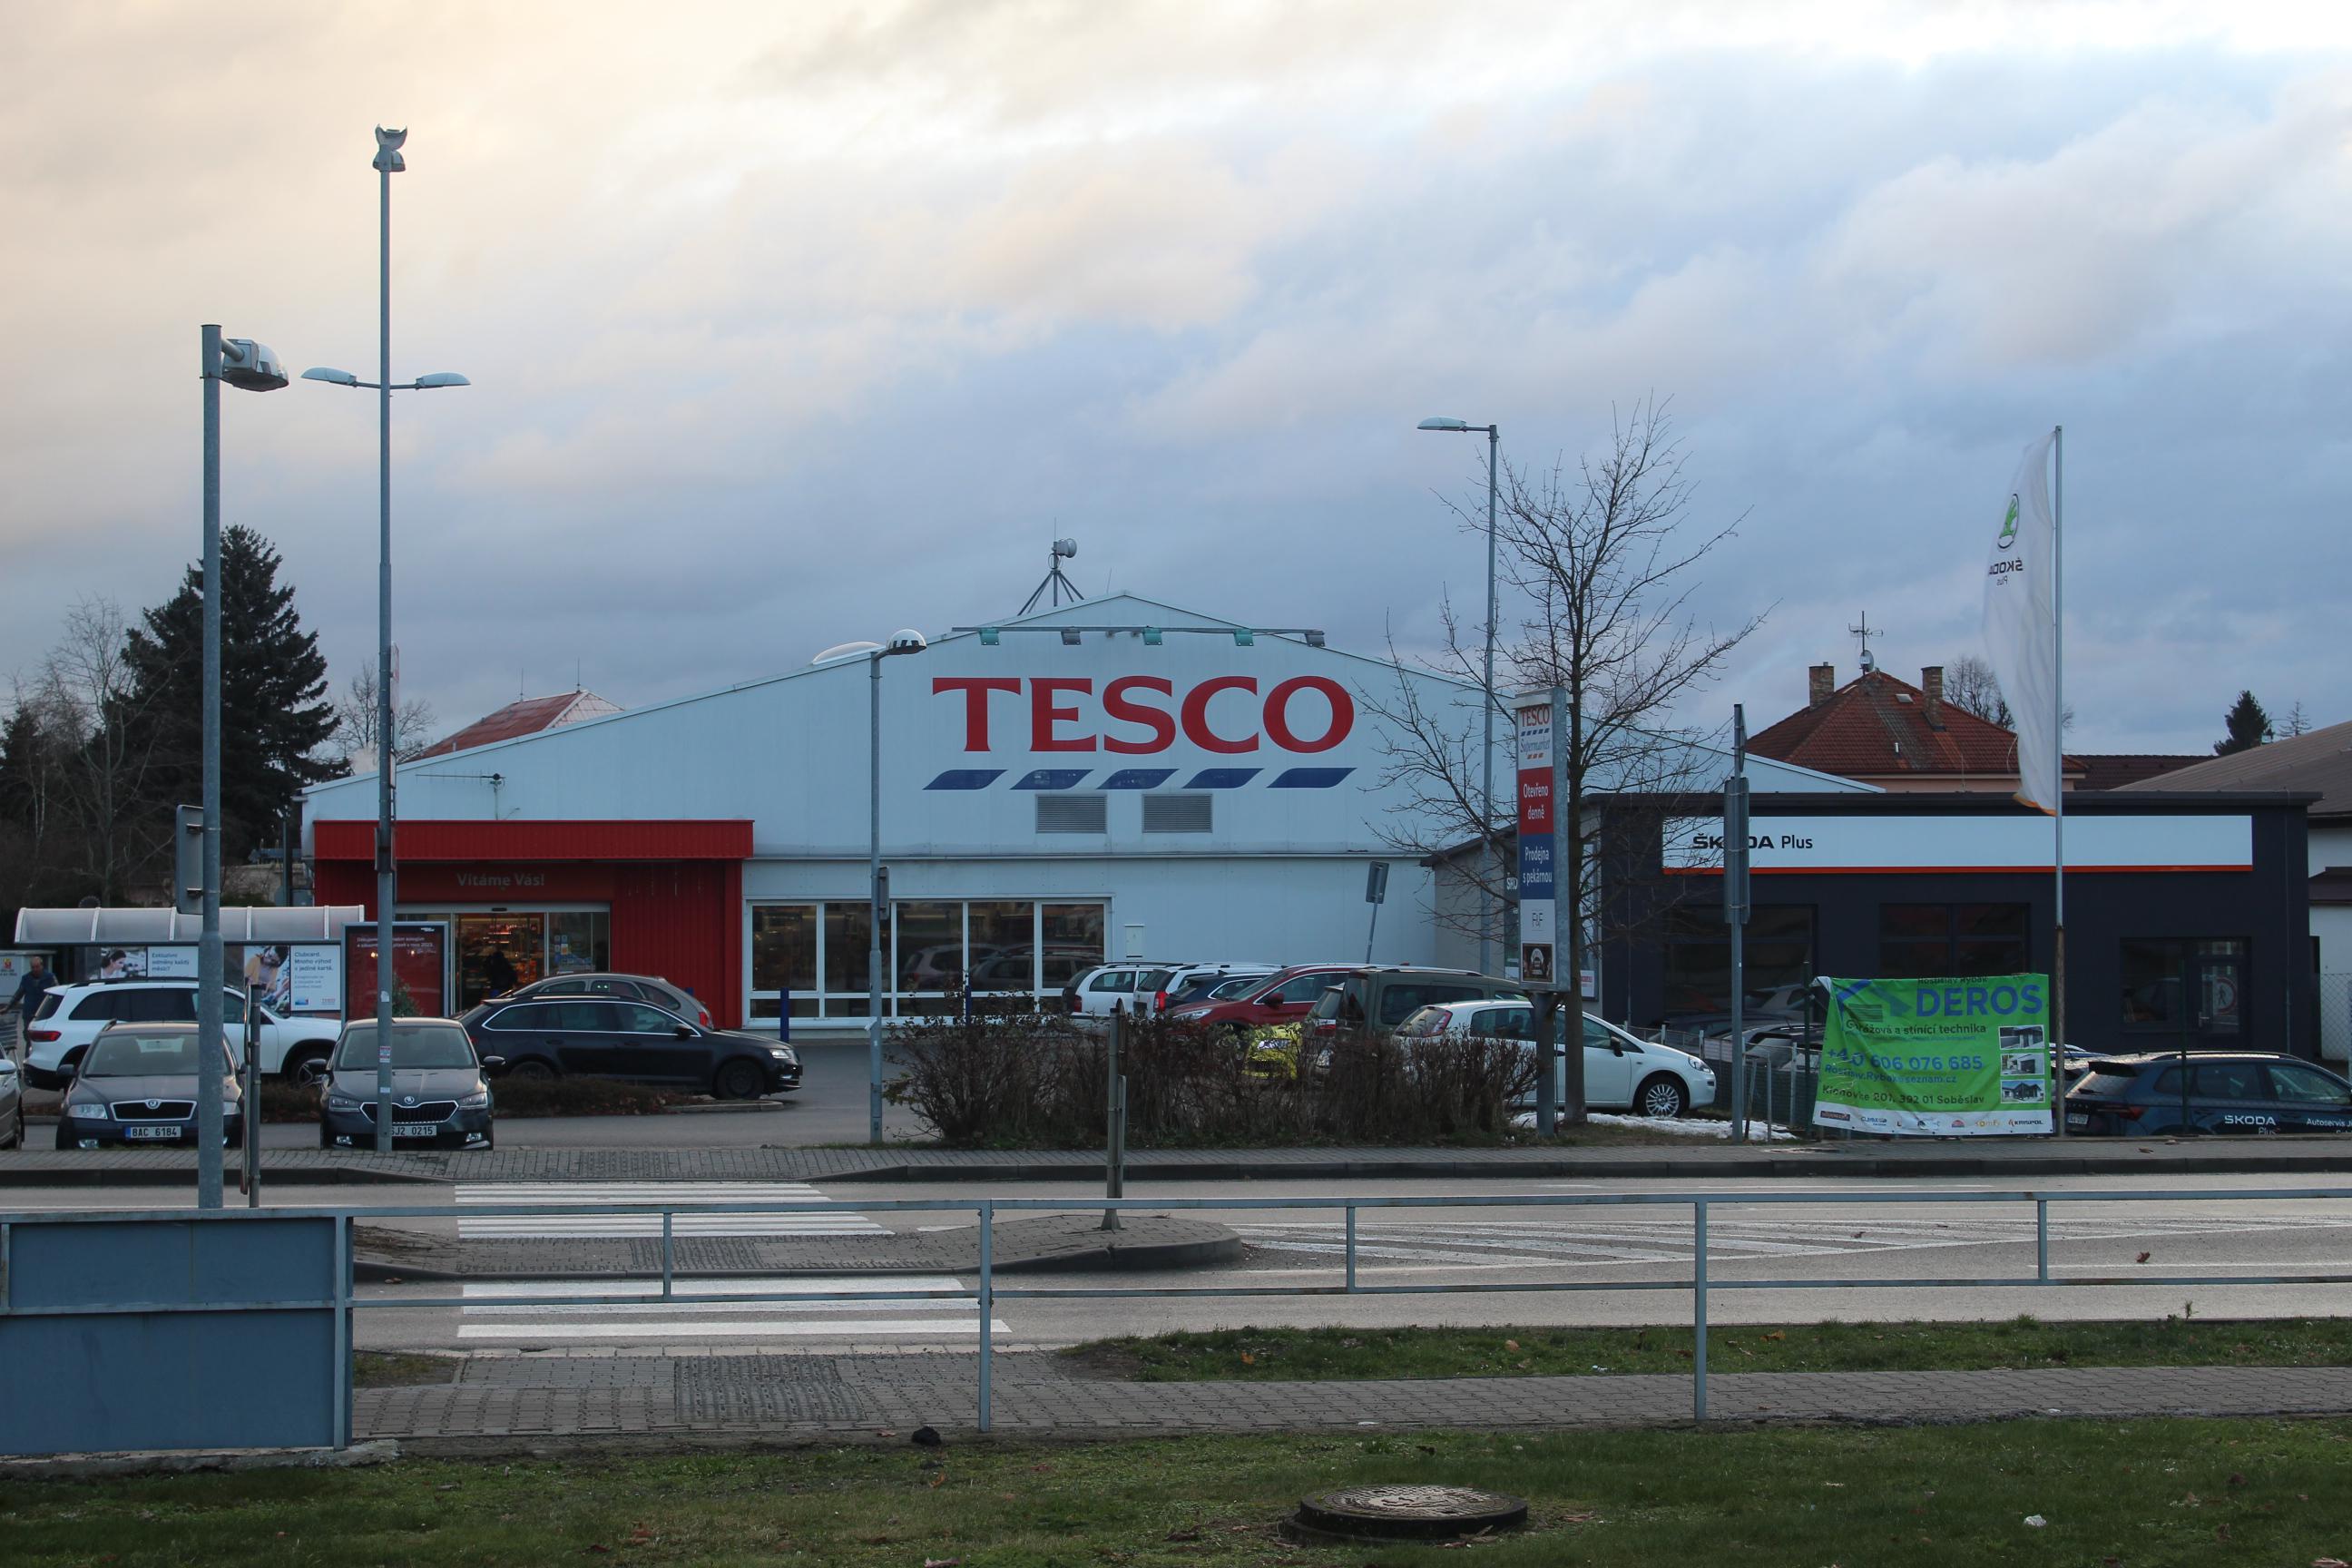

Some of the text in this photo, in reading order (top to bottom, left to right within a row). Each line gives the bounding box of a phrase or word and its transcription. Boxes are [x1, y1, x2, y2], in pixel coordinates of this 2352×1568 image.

[932, 675, 1355, 754] TESCO
[1520, 706, 1550, 728] TESCO
[1520, 739, 1551, 755] Supermarket
[1523, 782, 1549, 799] Otevřeno
[1527, 805, 1544, 819] denně
[1692, 833, 1813, 849] ŠKDA Plus
[1524, 847, 1549, 864] Prodejna
[514, 871, 544, 886] Vás!
[1523, 870, 1553, 887] s pekárnou
[1916, 985, 2042, 1017] DEROS
[1904, 1024, 1936, 1034] stínící
[1938, 1023, 1986, 1034] technika
[1870, 1055, 1903, 1070] 606
[1909, 1056, 1943, 1071] 076
[1949, 1055, 1984, 1070] 685
[1922, 1095, 1934, 1104] 01
[1936, 1094, 1985, 1105] Soběslav
[412, 1126, 433, 1135] 0215
[2306, 1117, 2346, 1128] Autoservis
